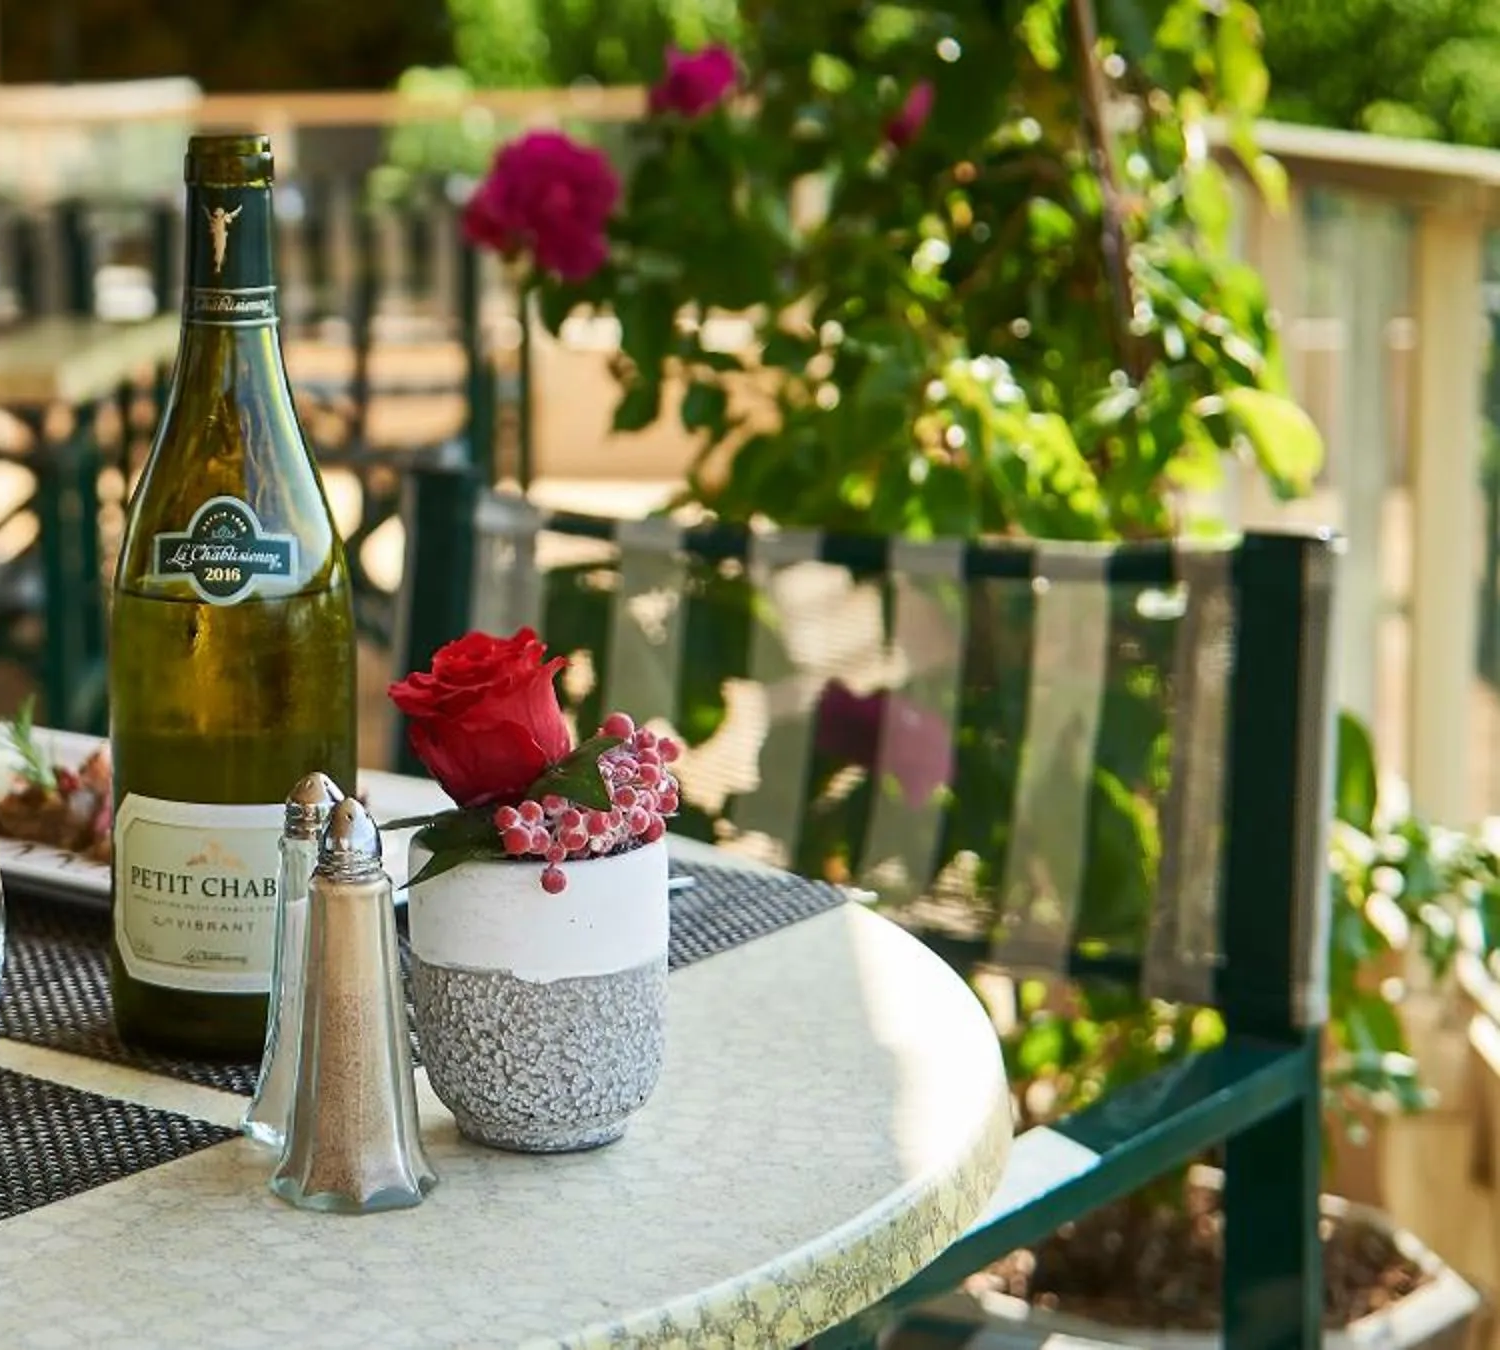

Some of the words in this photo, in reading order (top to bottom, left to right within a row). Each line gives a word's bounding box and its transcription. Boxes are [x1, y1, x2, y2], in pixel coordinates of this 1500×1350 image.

[204, 568, 241, 581] 2016
[131, 865, 193, 895] PETIT
[201, 877, 277, 898] CHAB
[177, 920, 255, 933] VIBRANT
